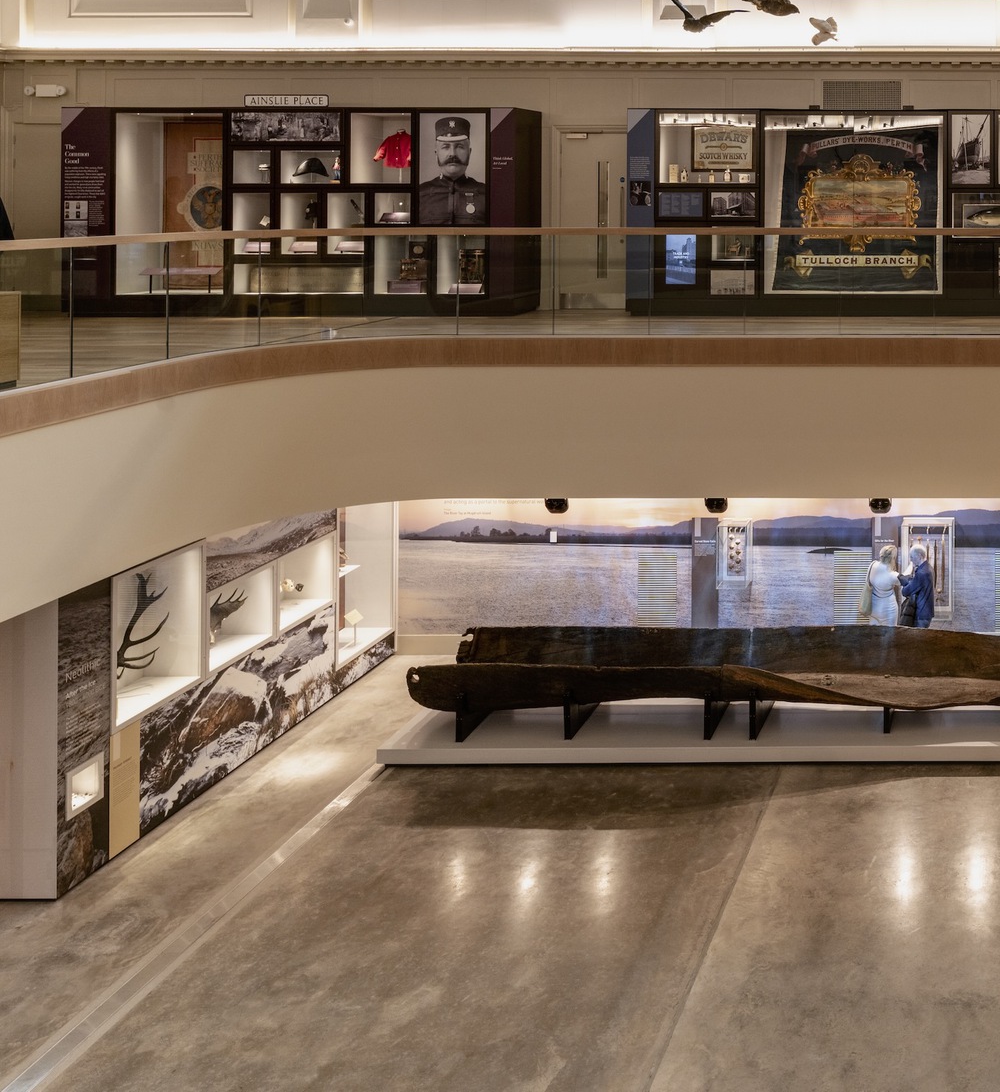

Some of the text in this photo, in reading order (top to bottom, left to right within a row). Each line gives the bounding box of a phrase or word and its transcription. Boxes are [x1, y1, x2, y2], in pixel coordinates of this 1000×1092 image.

[250, 96, 324, 105] AINSLIE PLACE
[886, 138, 913, 151] PERTH
[699, 152, 748, 160] SCOTCH WHISKY
[802, 257, 916, 265] TULLOCH BRANCH.
[65, 659, 100, 683] Neolithic
